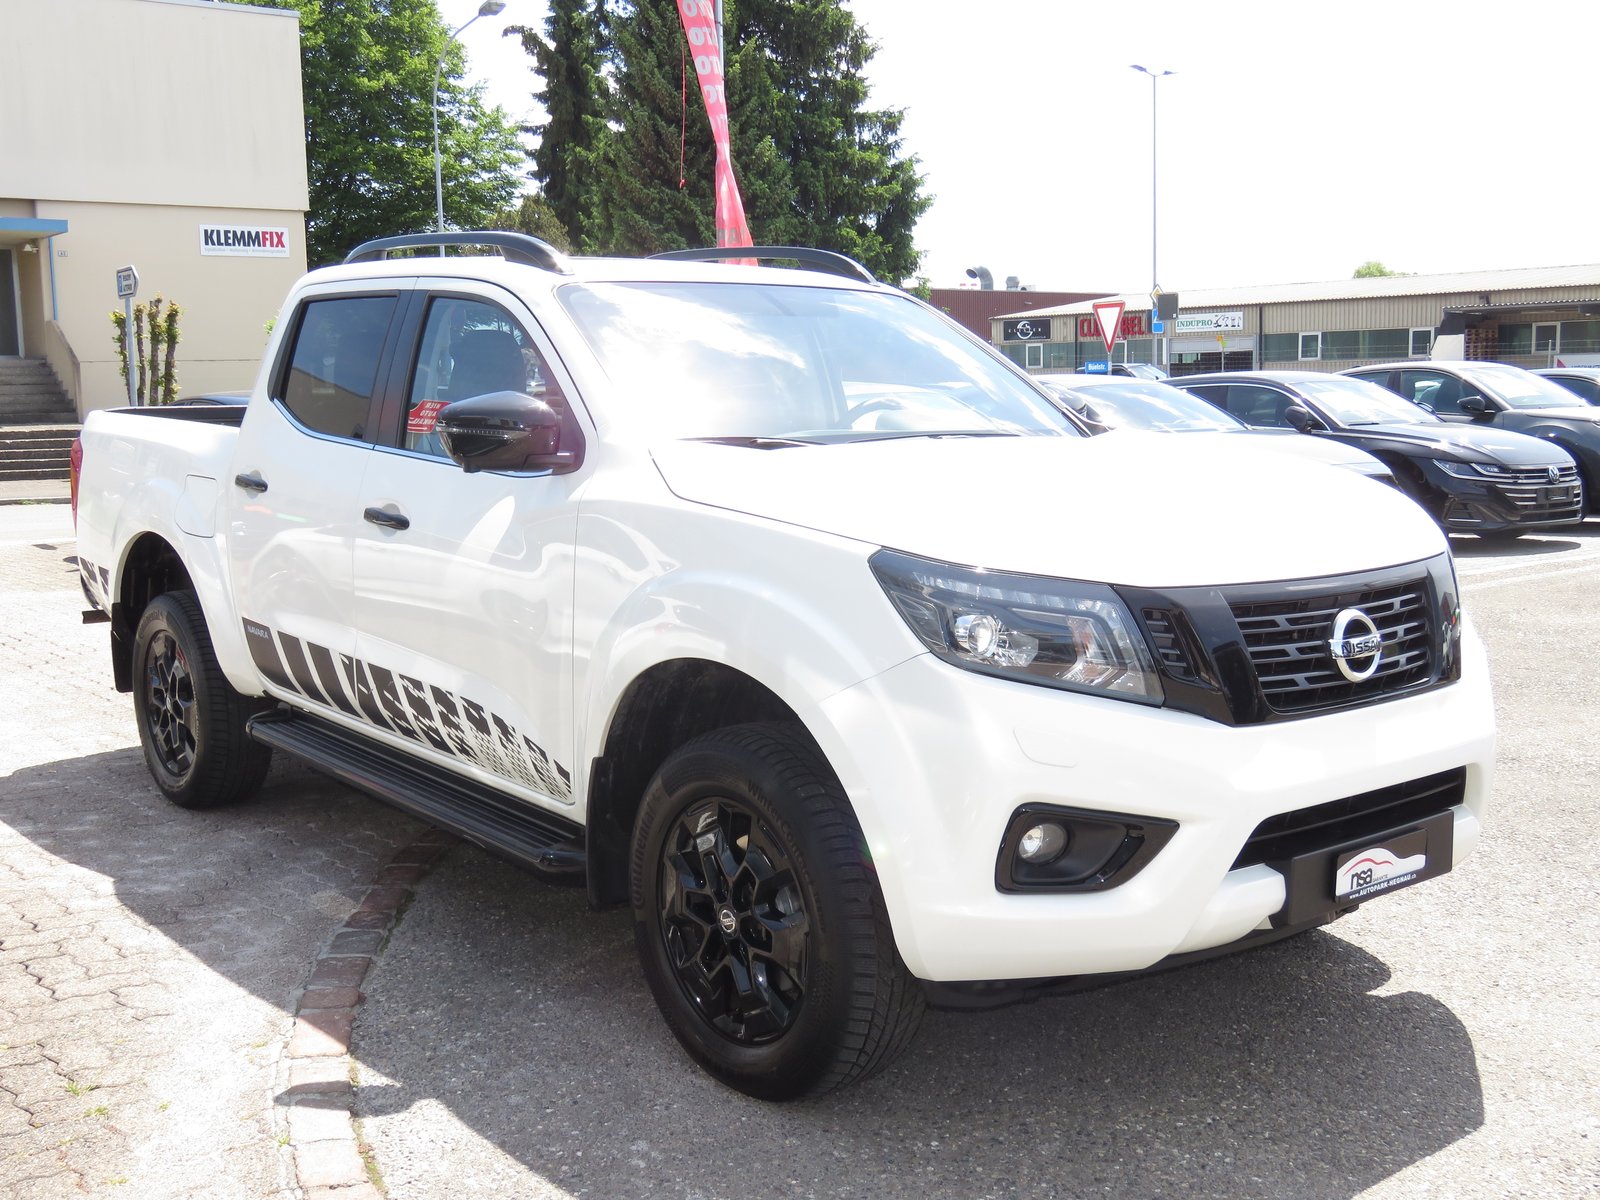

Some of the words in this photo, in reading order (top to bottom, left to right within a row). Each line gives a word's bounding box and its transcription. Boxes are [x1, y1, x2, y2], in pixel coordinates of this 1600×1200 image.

[203, 229, 286, 248] KLEMMFIX
[1177, 319, 1213, 328] INDUPRO
[247, 624, 269, 640] NAVARA
[1341, 638, 1380, 656] NISSAN
[1349, 873, 1417, 899] www.AUTOPARK-HEGNAU.ch
[1351, 868, 1373, 890] nsa
